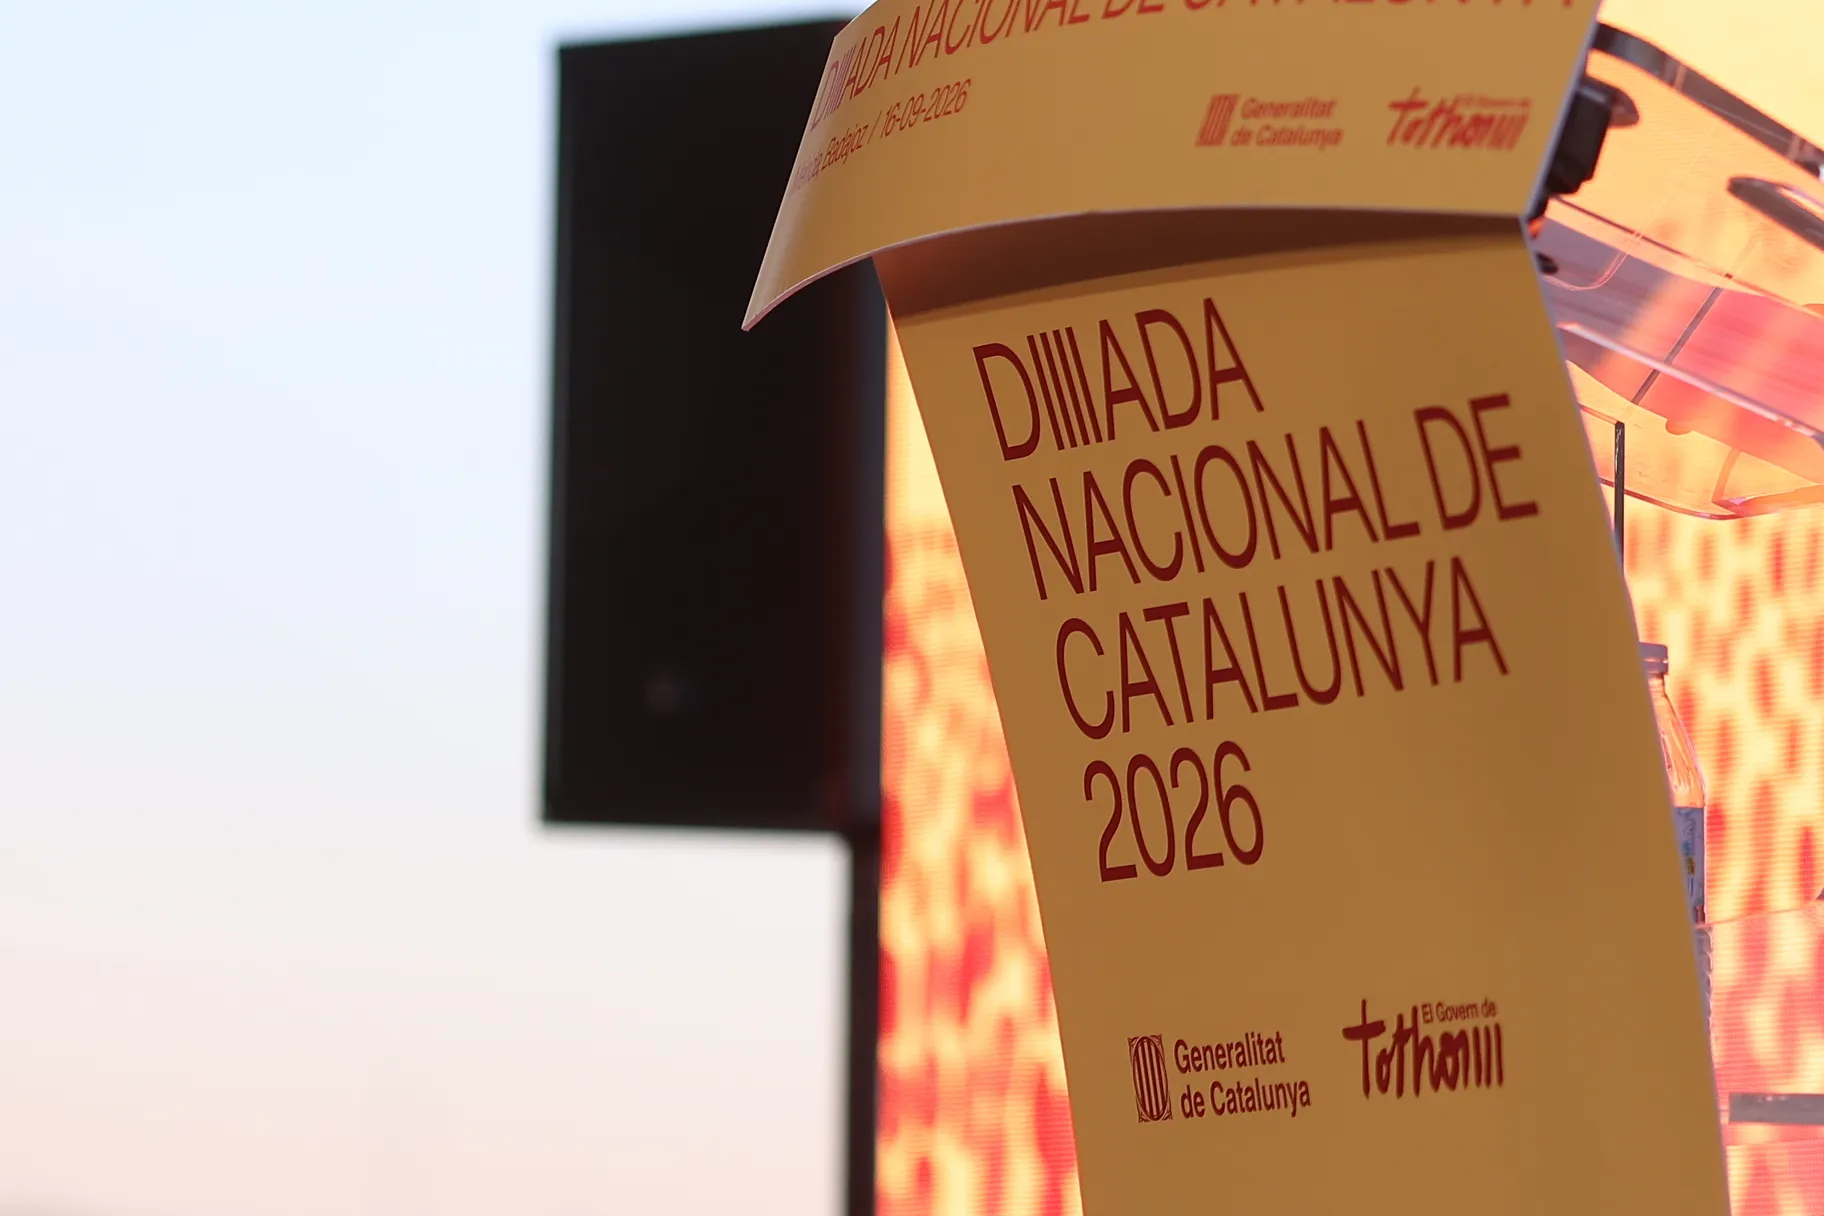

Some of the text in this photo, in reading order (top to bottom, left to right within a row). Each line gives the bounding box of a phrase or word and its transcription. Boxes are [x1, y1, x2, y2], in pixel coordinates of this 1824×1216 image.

[880, 78, 972, 139] 16-09-2026
[1240, 95, 1338, 120] Generalitat
[1230, 124, 1345, 152] de Catalunya
[1011, 392, 1540, 601] NACIONAL DE
[1055, 555, 1510, 741] CATALUNYA
[1082, 740, 1265, 884] 2026
[1420, 1003, 1434, 1025] El
[1481, 997, 1497, 1019] de
[1173, 1030, 1286, 1075] Generalitat
[1180, 1077, 1312, 1120] de Catalunya
